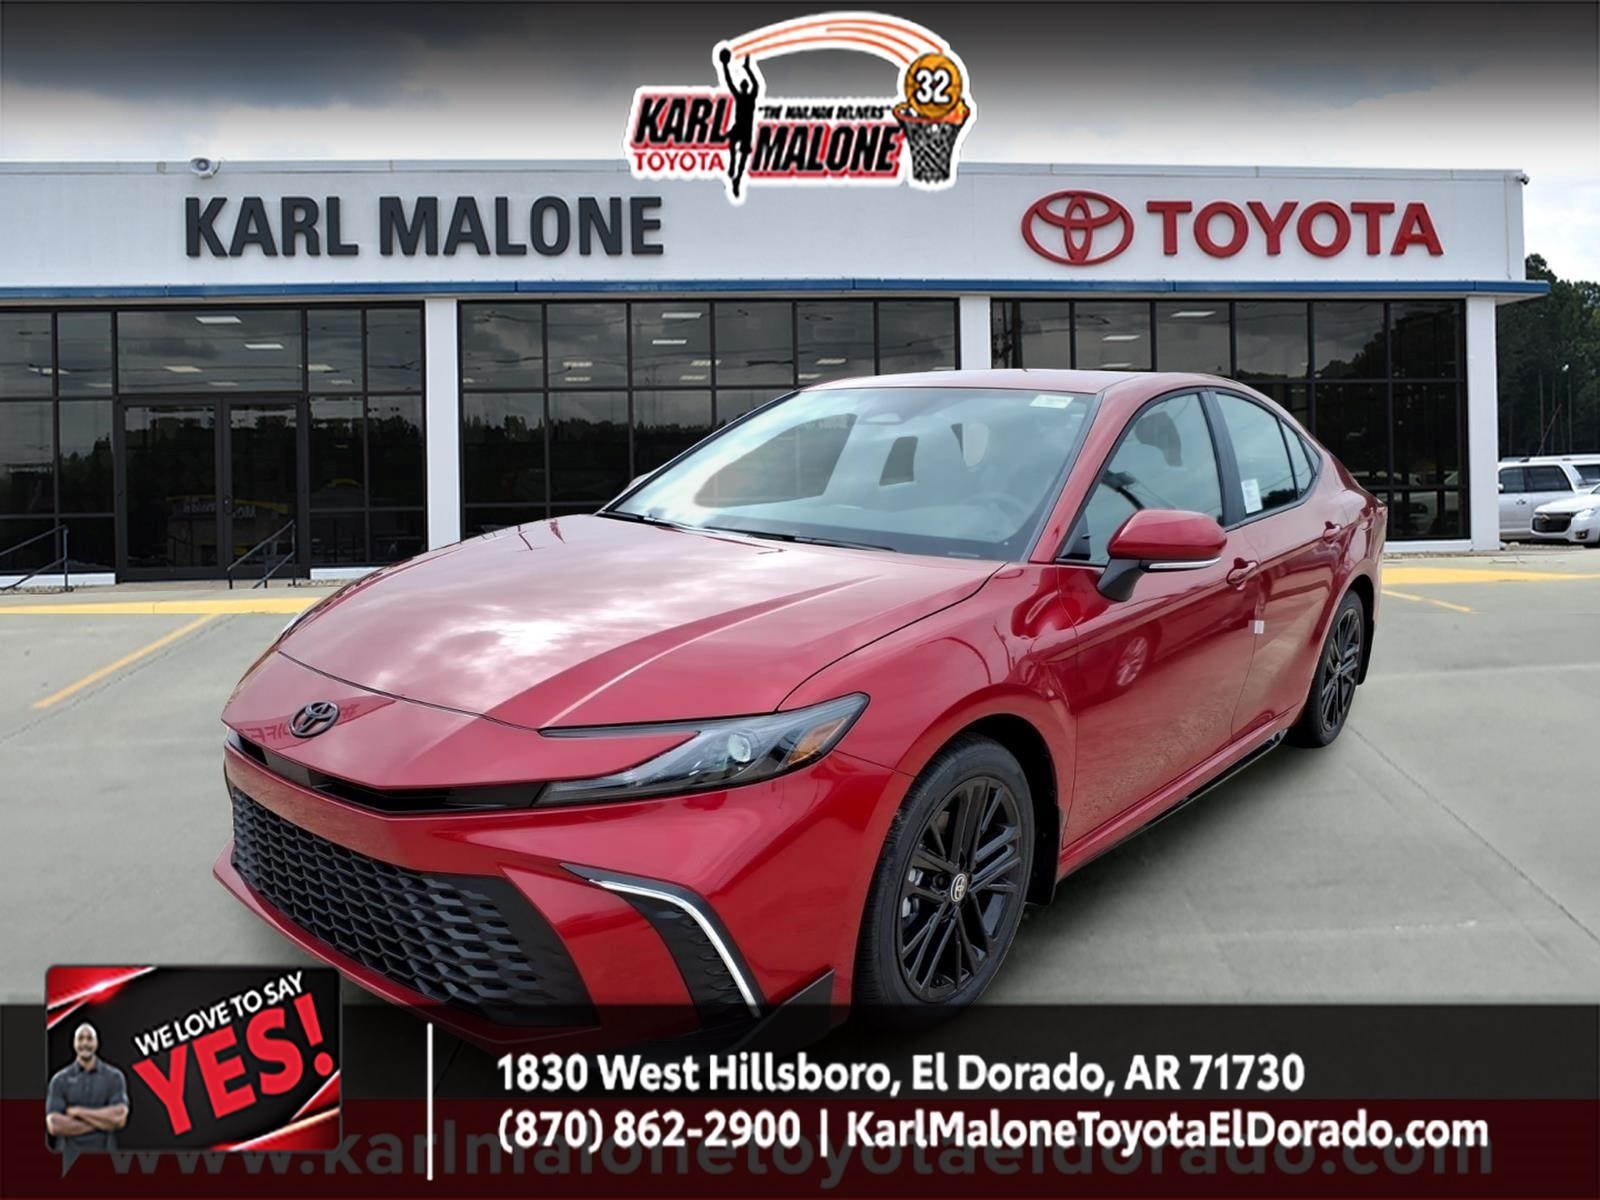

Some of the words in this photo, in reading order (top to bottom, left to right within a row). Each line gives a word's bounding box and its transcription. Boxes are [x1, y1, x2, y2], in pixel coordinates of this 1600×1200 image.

[185, 196, 360, 257] KARL
[379, 196, 664, 256] MALONE
[1146, 201, 1444, 258] TOYOTA
